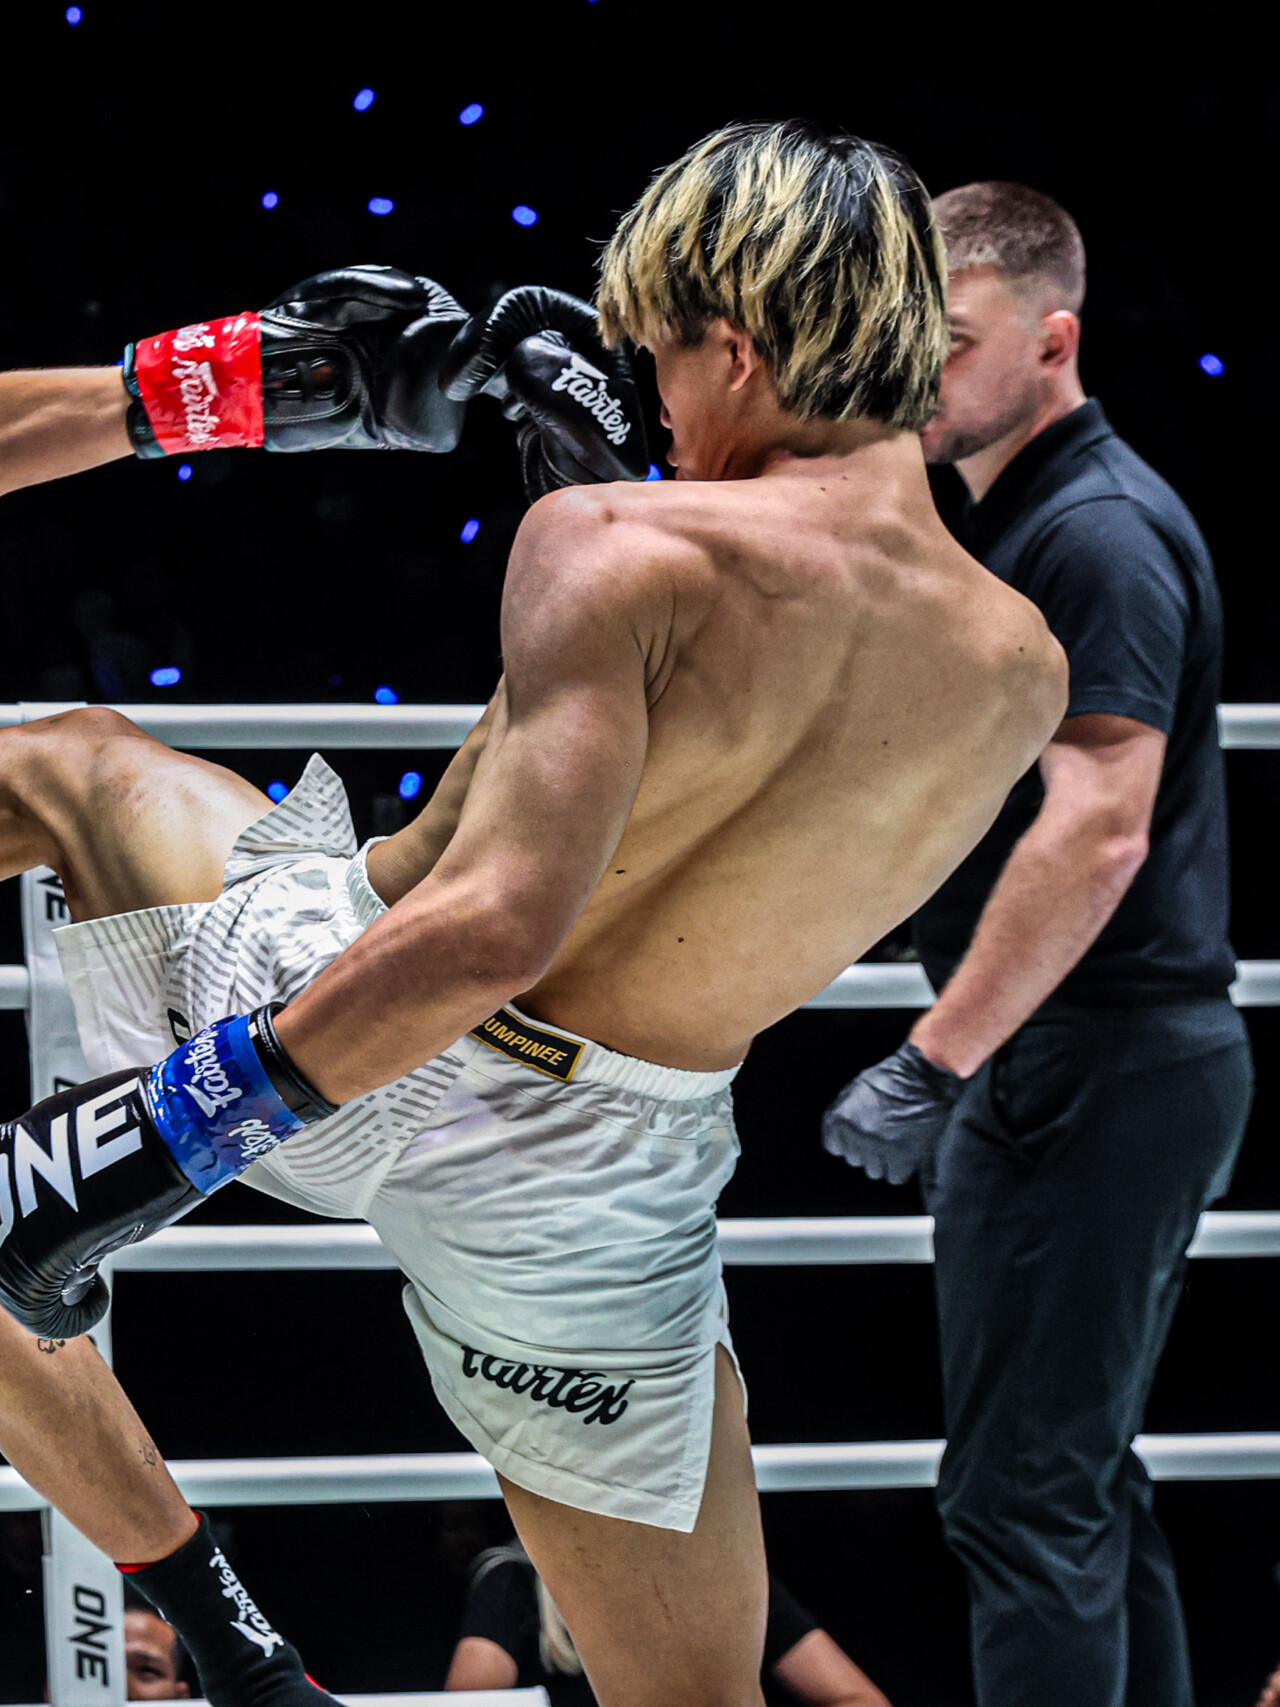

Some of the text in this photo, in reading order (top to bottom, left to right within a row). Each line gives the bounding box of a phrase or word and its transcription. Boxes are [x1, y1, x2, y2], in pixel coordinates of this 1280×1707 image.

[551, 352, 631, 445] Fairtex
[182, 1029, 243, 1118] Fairtex
[481, 1017, 569, 1066] UMPINEE
[67, 1583, 115, 1688] ONE
[209, 1546, 285, 1658] Fairtex
